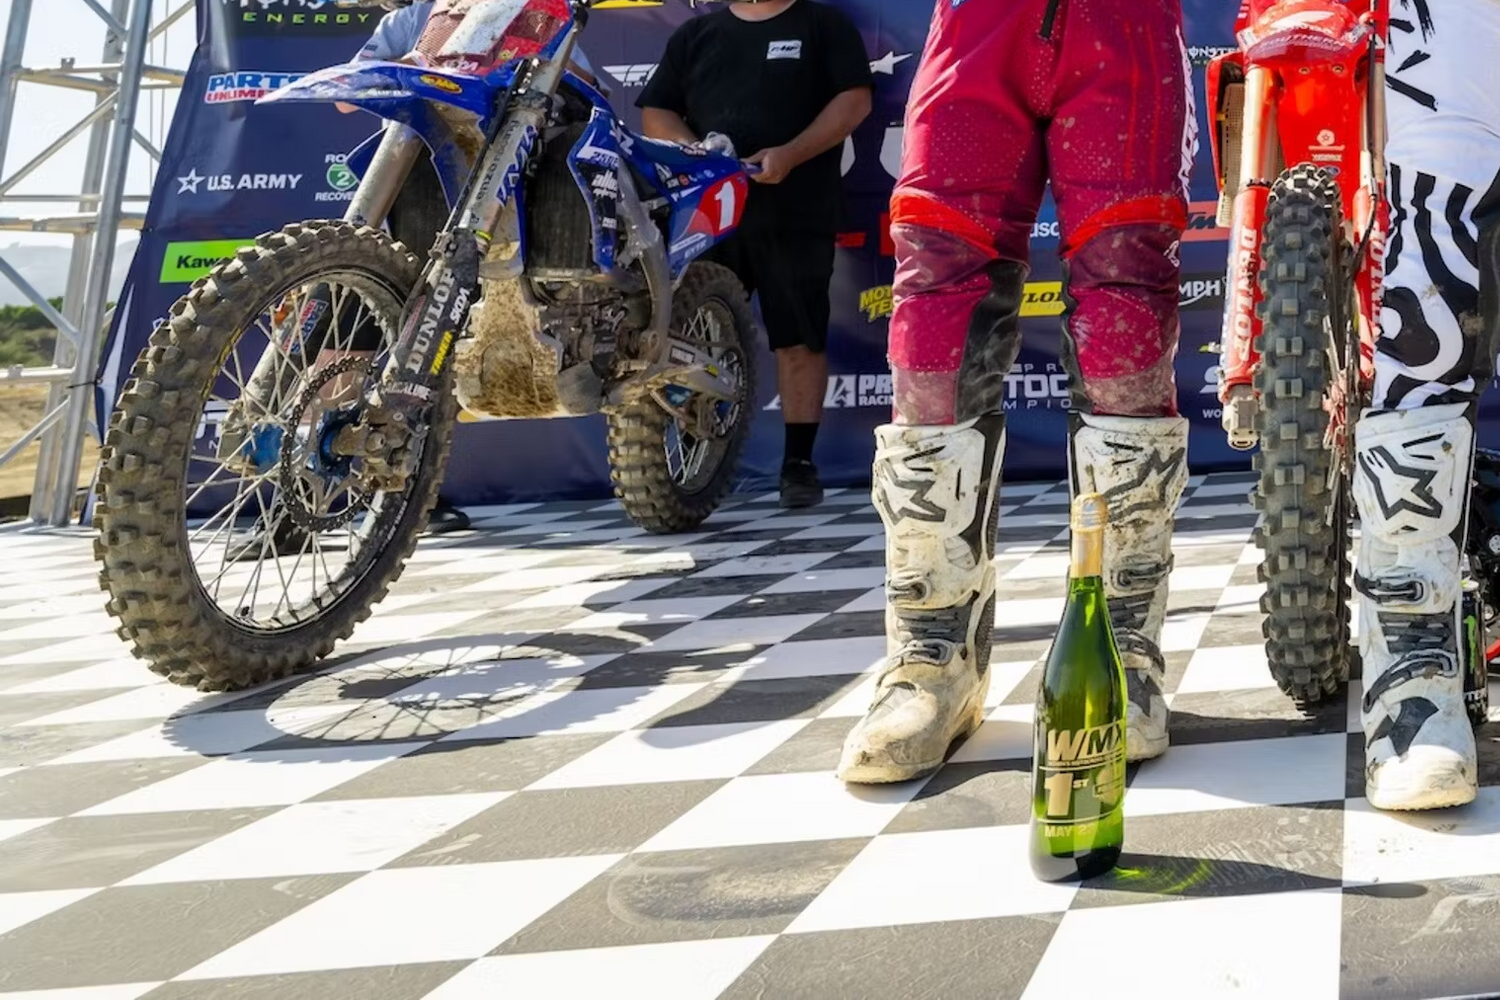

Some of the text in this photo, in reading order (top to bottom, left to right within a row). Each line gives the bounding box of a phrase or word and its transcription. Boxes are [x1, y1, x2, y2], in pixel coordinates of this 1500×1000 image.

[242, 12, 370, 24] ENERGY
[207, 174, 303, 191] U.S. ARMY
[335, 170, 351, 186] 2
[714, 180, 736, 232] 1
[405, 267, 456, 375] DUNLOP
[1044, 824, 1074, 839] MAY
